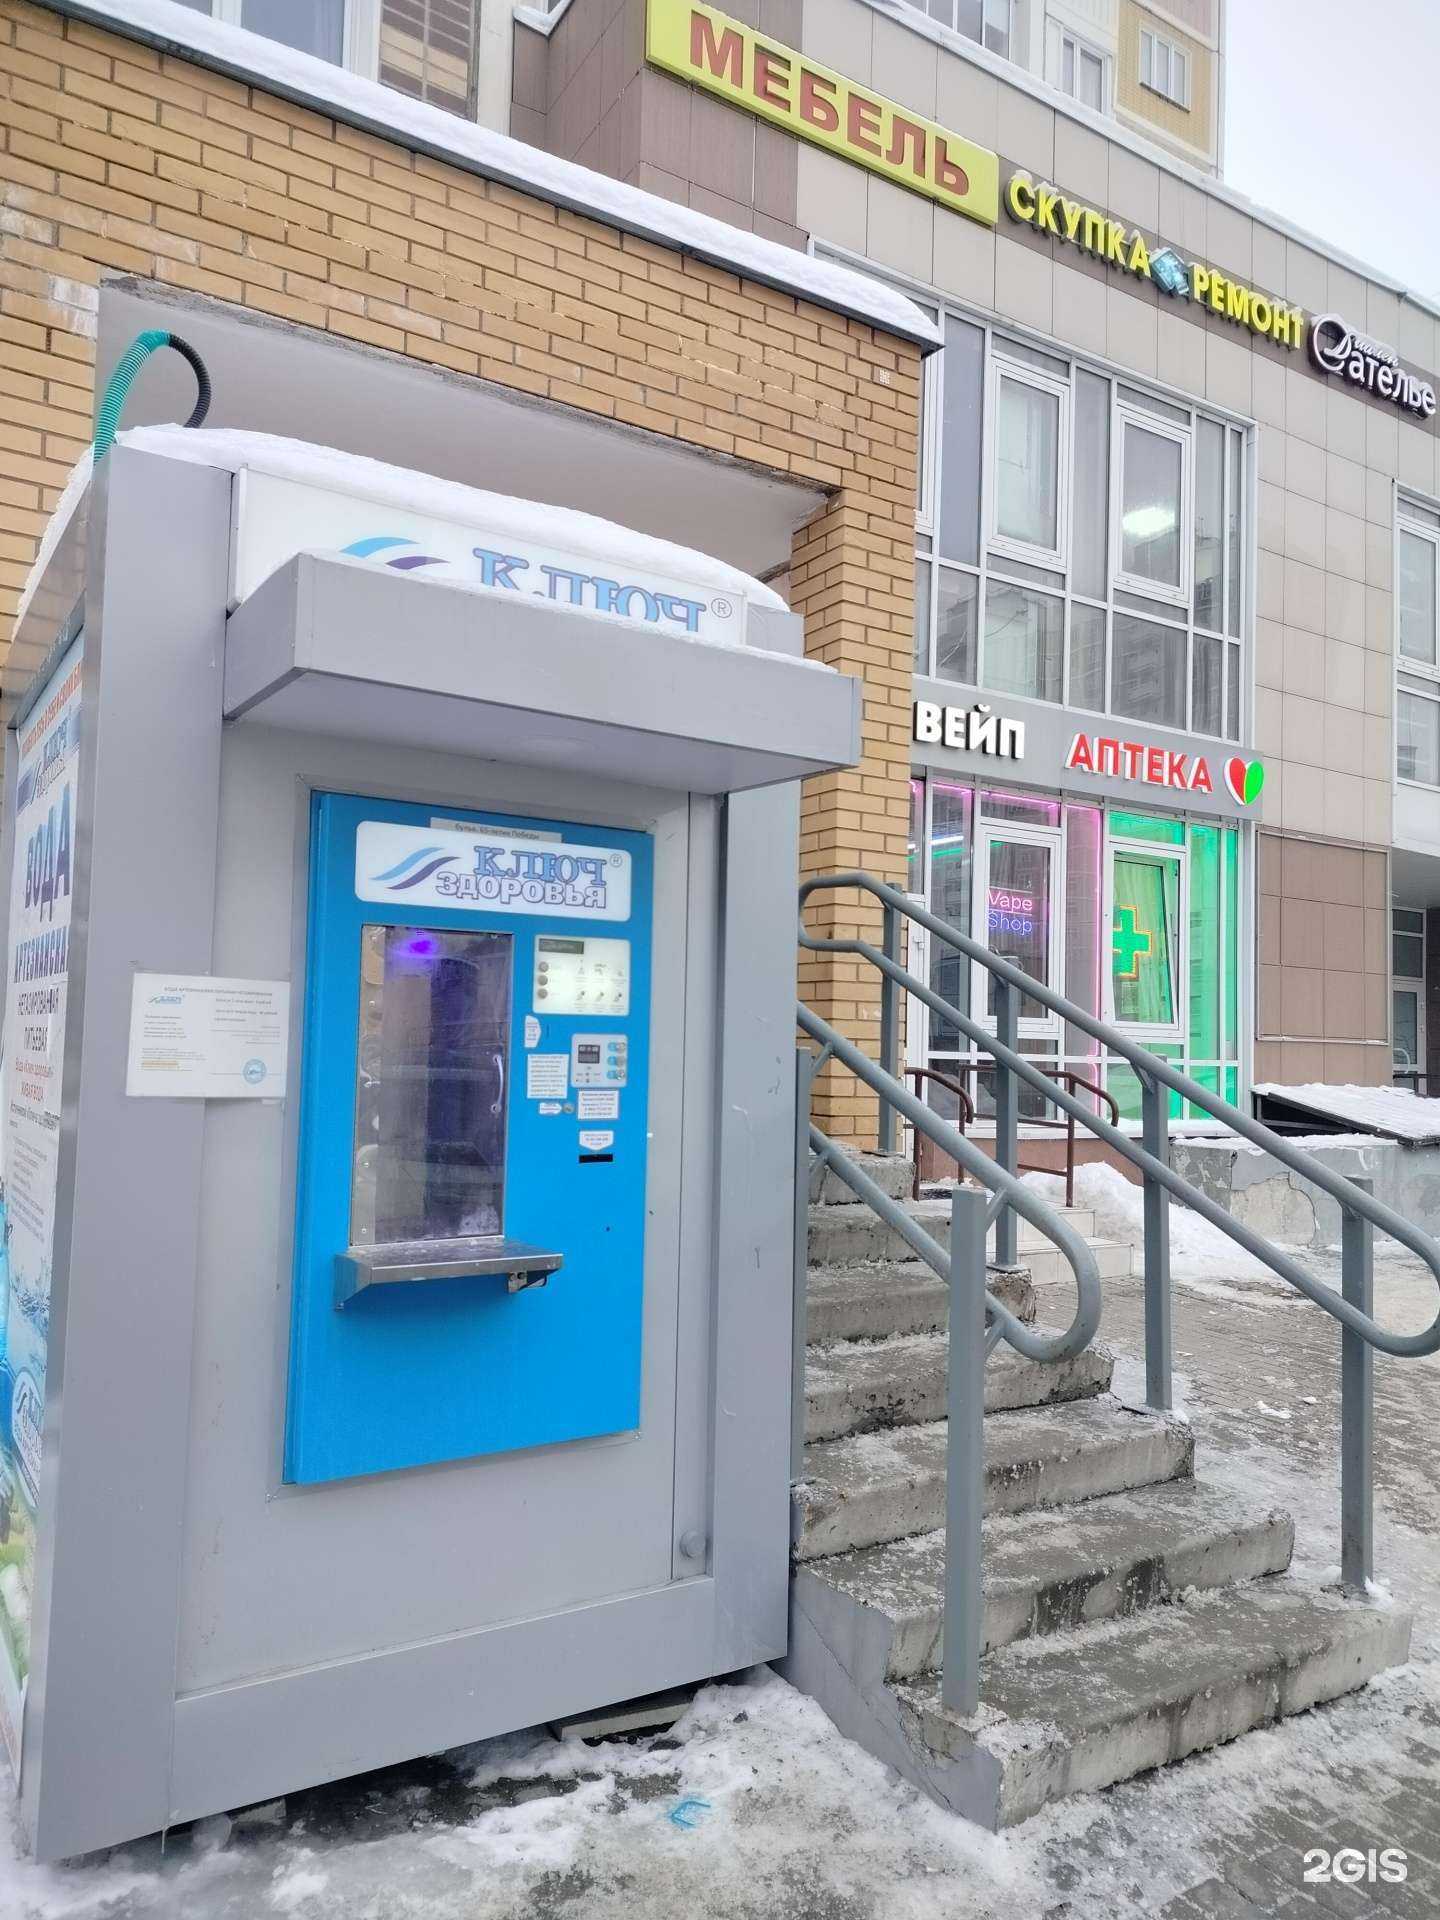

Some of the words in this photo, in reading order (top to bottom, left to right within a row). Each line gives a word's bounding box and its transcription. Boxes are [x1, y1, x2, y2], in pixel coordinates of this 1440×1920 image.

[690, 9, 970, 196] МЕБЕЛЬ
[1008, 177, 1152, 277] СКУПКА
[1192, 262, 1304, 350] РЕМОНТ
[1348, 350, 1437, 415] ателье
[915, 700, 1025, 759] ВЕЙП
[1065, 733, 1214, 793] АПТЕКА
[25, 783, 70, 922] ВОДА
[473, 845, 607, 886] КЛЮЧ
[436, 871, 607, 909] ЗДОРОВЬЯ
[987, 889, 1033, 912] Vape
[987, 911, 1033, 935] Shop
